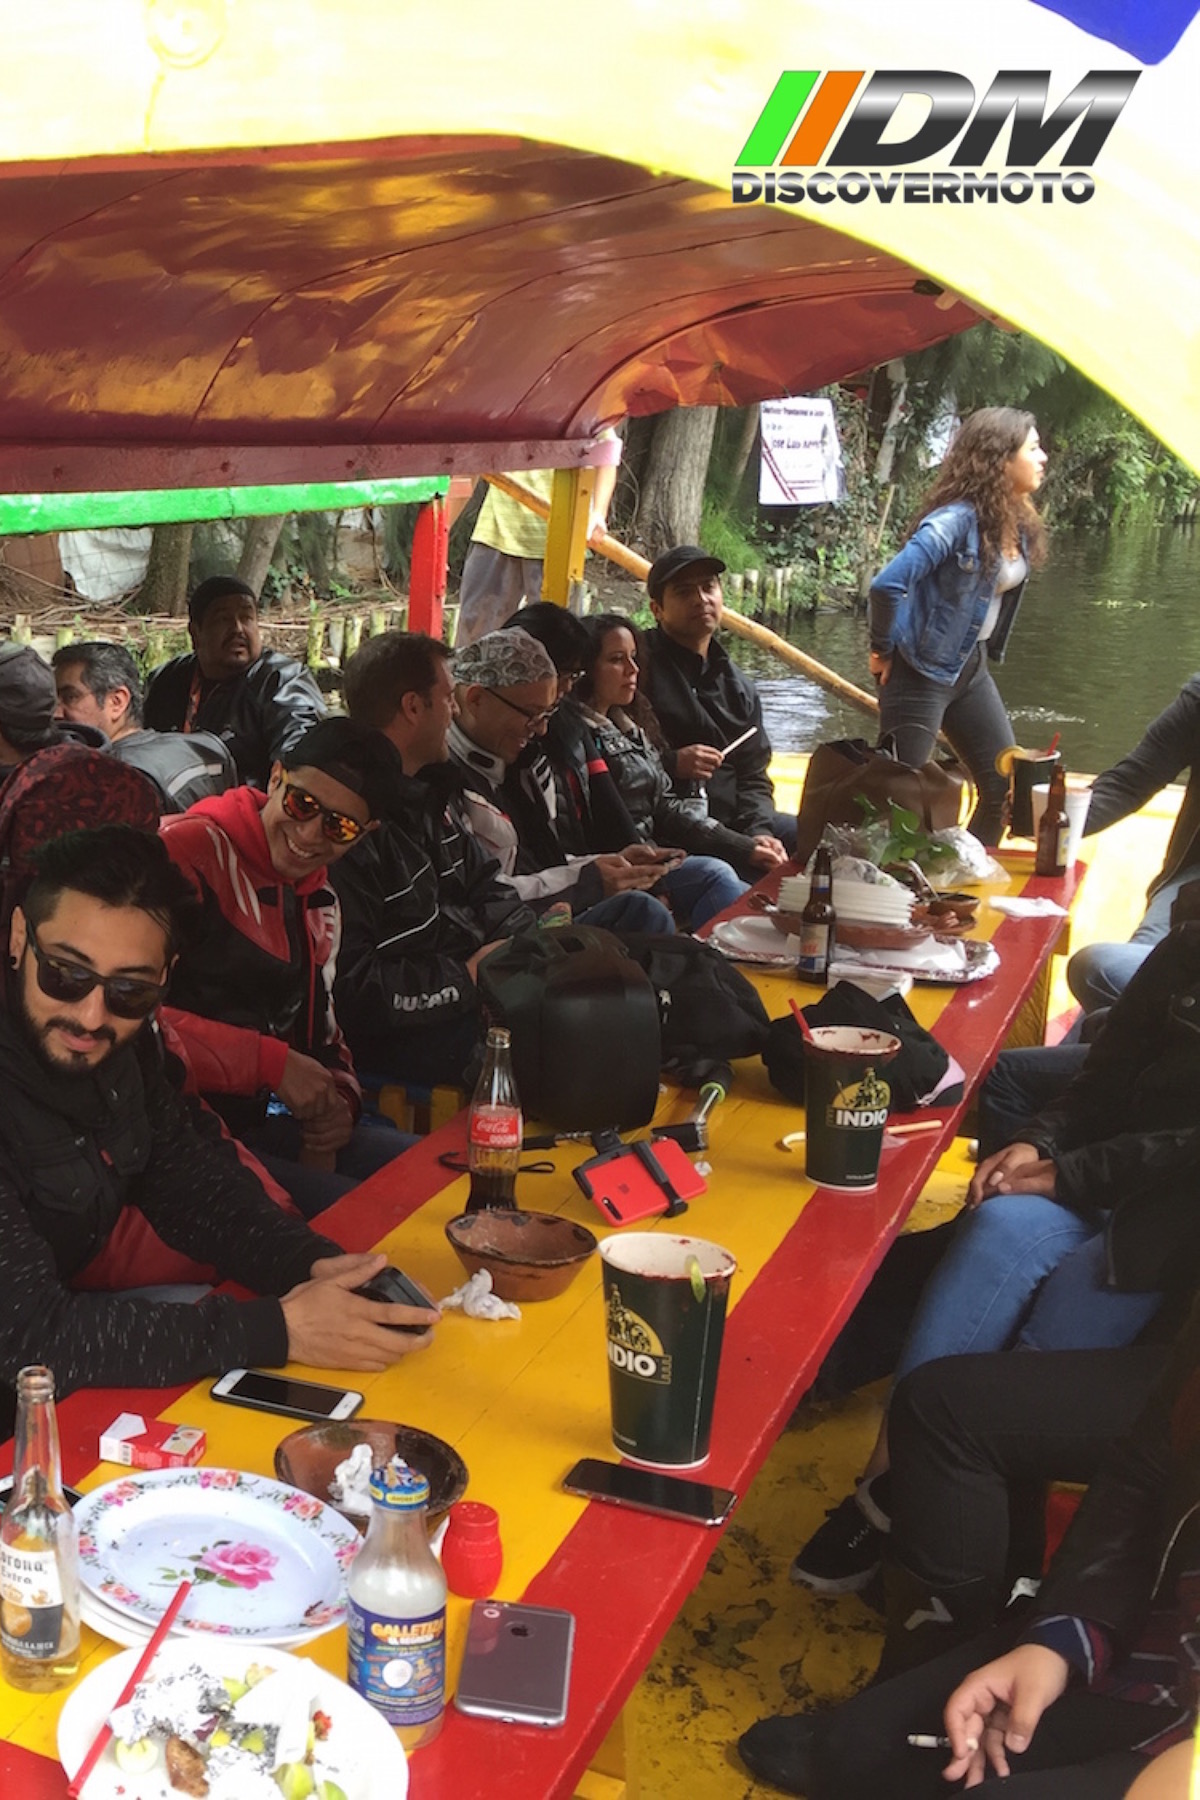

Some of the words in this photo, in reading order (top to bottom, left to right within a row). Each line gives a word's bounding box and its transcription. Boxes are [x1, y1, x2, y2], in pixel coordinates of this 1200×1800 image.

[836, 1108, 889, 1127] INDIO
[608, 1342, 657, 1378] NDIO
[1, 1564, 33, 1585] Extra
